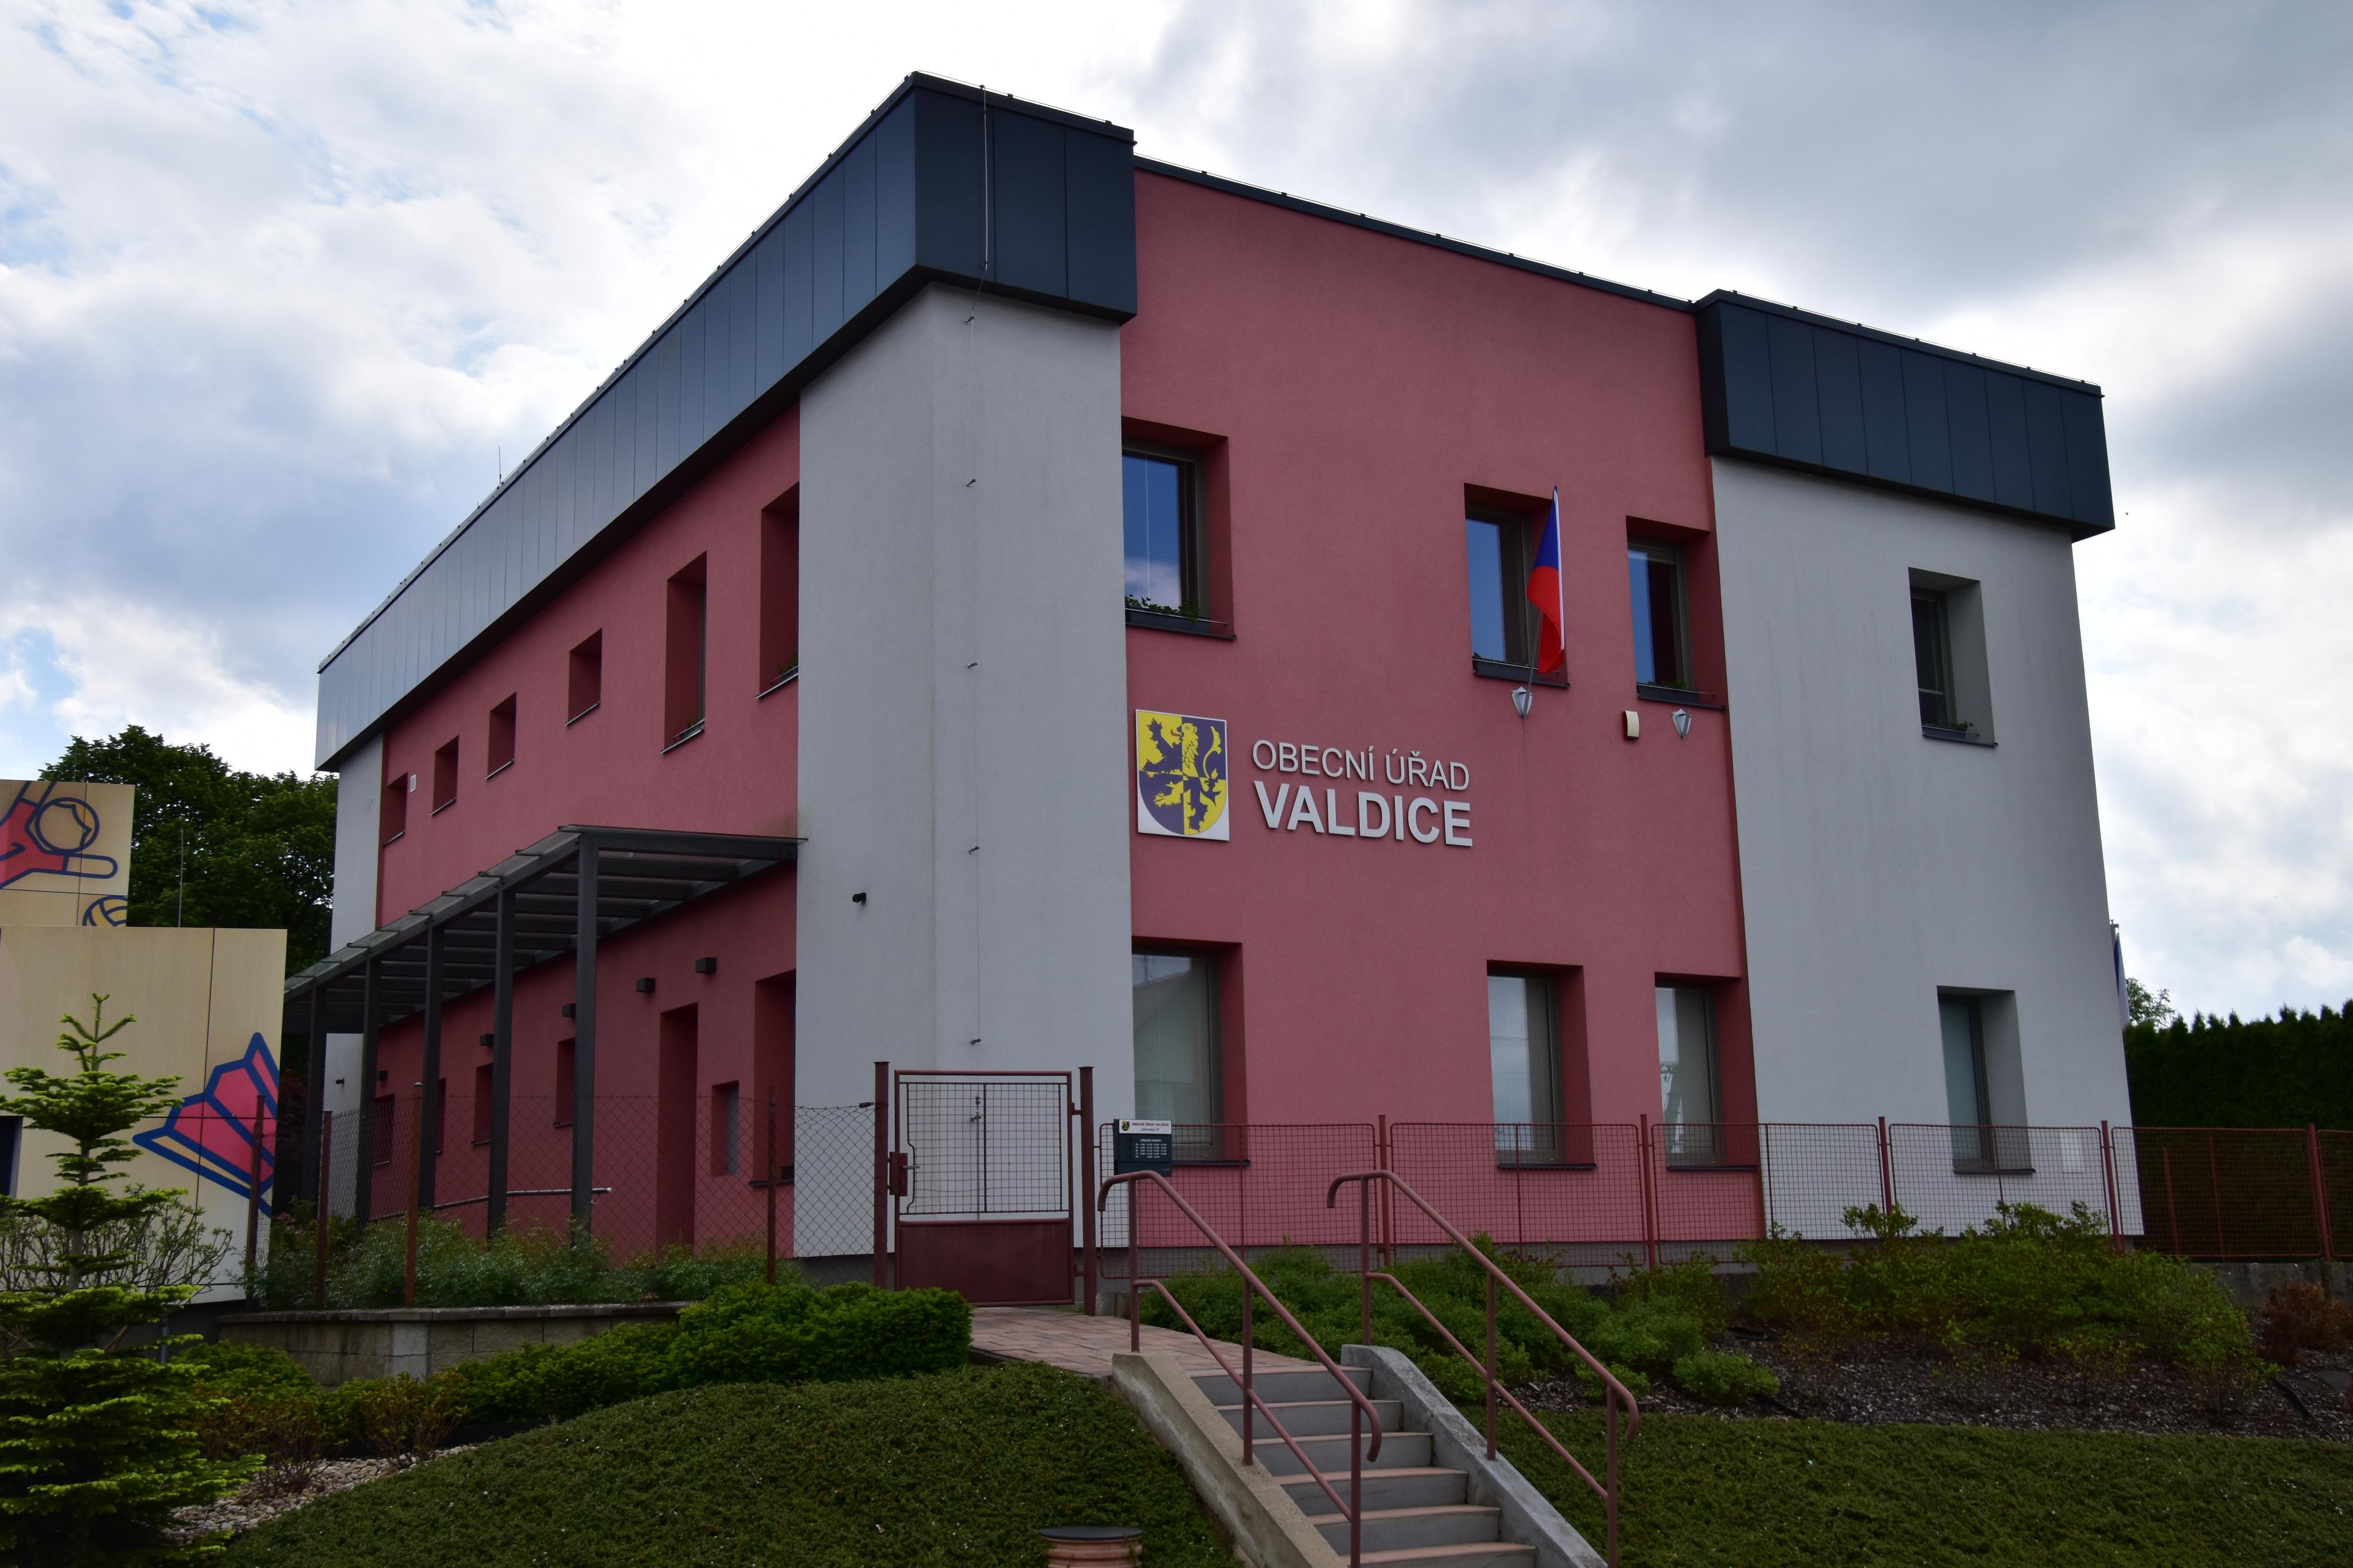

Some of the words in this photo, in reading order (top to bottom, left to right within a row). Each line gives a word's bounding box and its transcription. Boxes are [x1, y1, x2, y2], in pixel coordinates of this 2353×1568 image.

[1253, 740, 1374, 780] OBECNÍ
[1385, 749, 1469, 790] ÚŘAD
[1254, 780, 1473, 846] VALDICE
